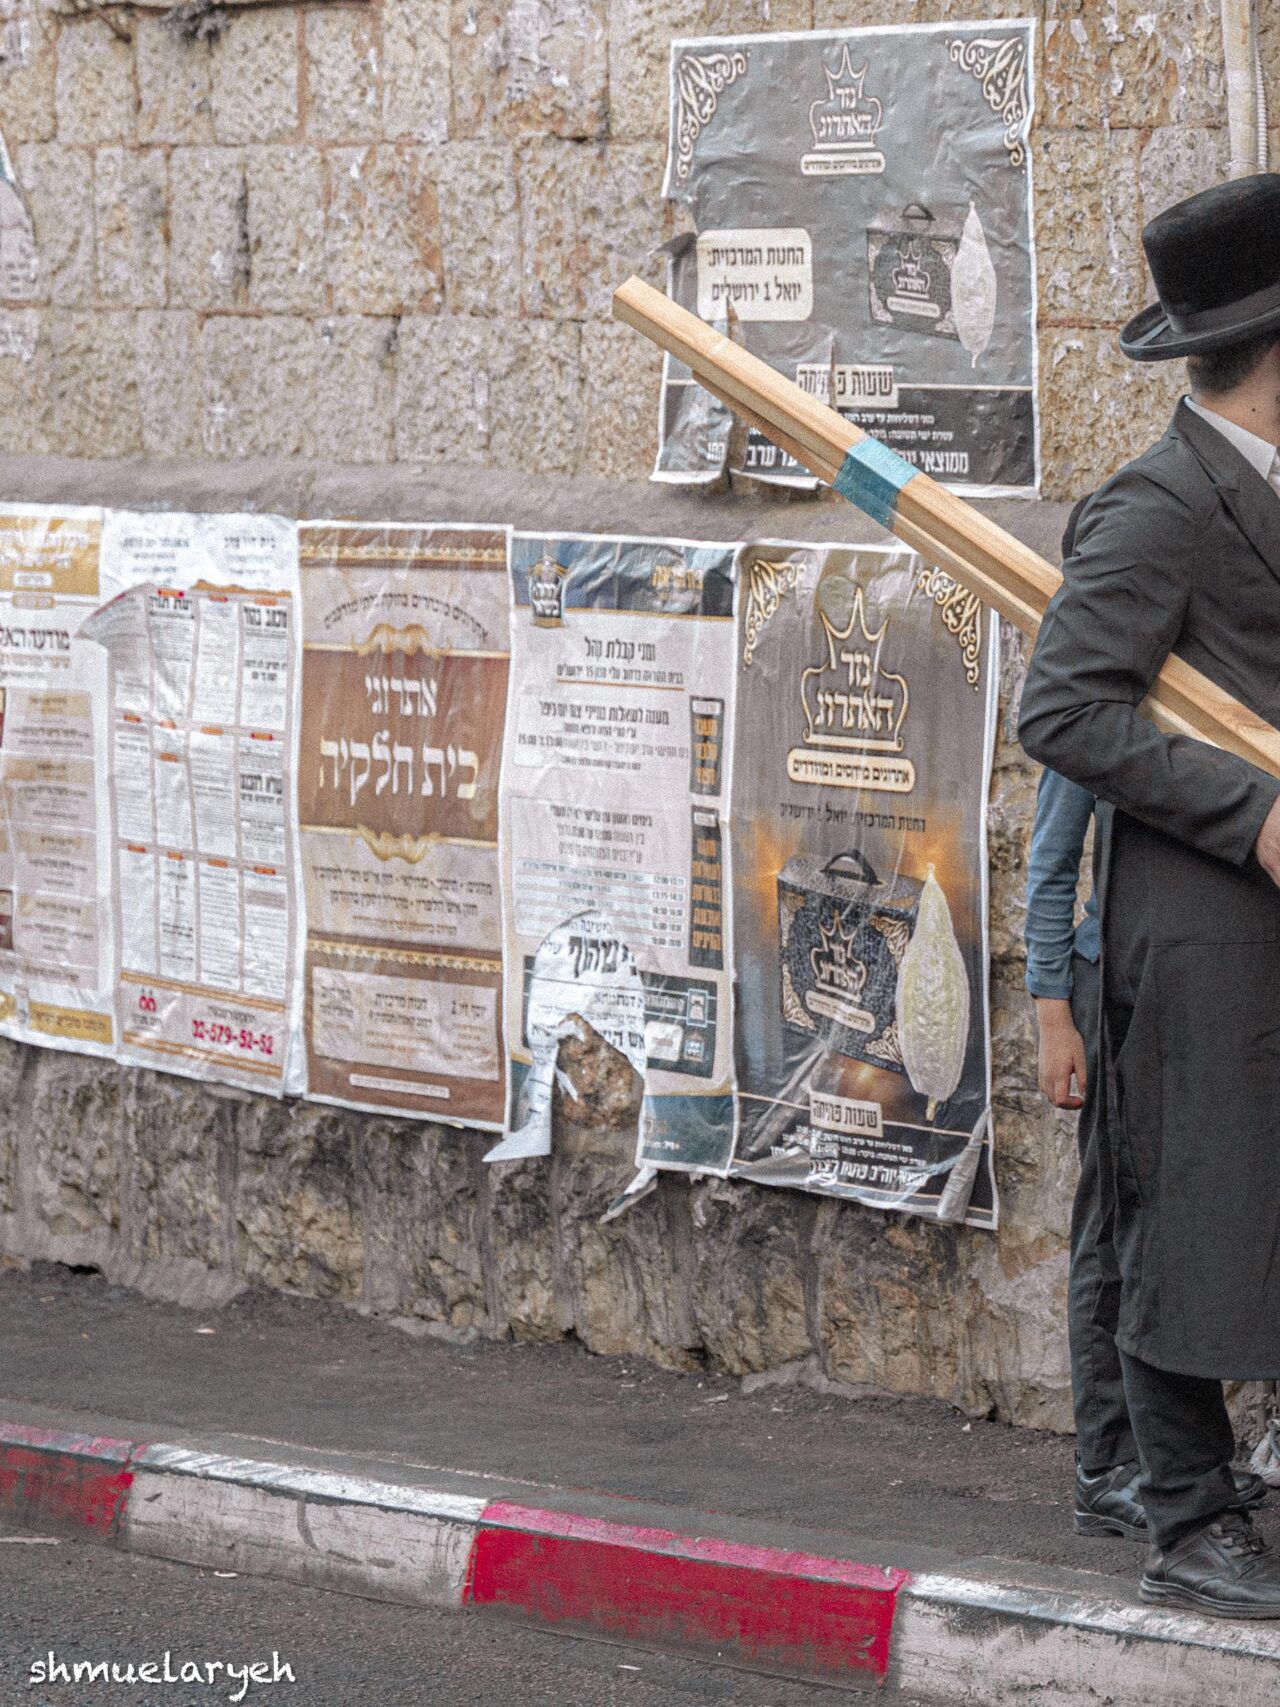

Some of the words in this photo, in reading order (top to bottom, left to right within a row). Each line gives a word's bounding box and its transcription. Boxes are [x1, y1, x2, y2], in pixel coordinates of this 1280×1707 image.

[836, 87, 855, 109] נזר
[819, 112, 872, 138] האתרוג
[766, 246, 804, 266] החנות
[711, 275, 760, 301] ירושלים
[764, 283, 771, 300] 1
[773, 275, 802, 301] יואל
[851, 371, 893, 397] שעות
[920, 450, 969, 474] ממוצאי
[584, 635, 604, 661] קהל
[606, 637, 635, 665] קבלת
[840, 650, 871, 688] נזר
[364, 673, 437, 718] אתרוגי
[608, 705, 643, 723] לשאלות
[814, 686, 894, 732] האתרוג
[319, 728, 414, 807] חלקיה
[420, 742, 479, 800] בית
[792, 757, 834, 777] ומהודרים
[872, 765, 910, 785] אתרוגים
[825, 802, 848, 824] יואל
[812, 1099, 842, 1124] פתיחה
[844, 1106, 878, 1129] שעות
[839, 1161, 869, 1181] פתוח
